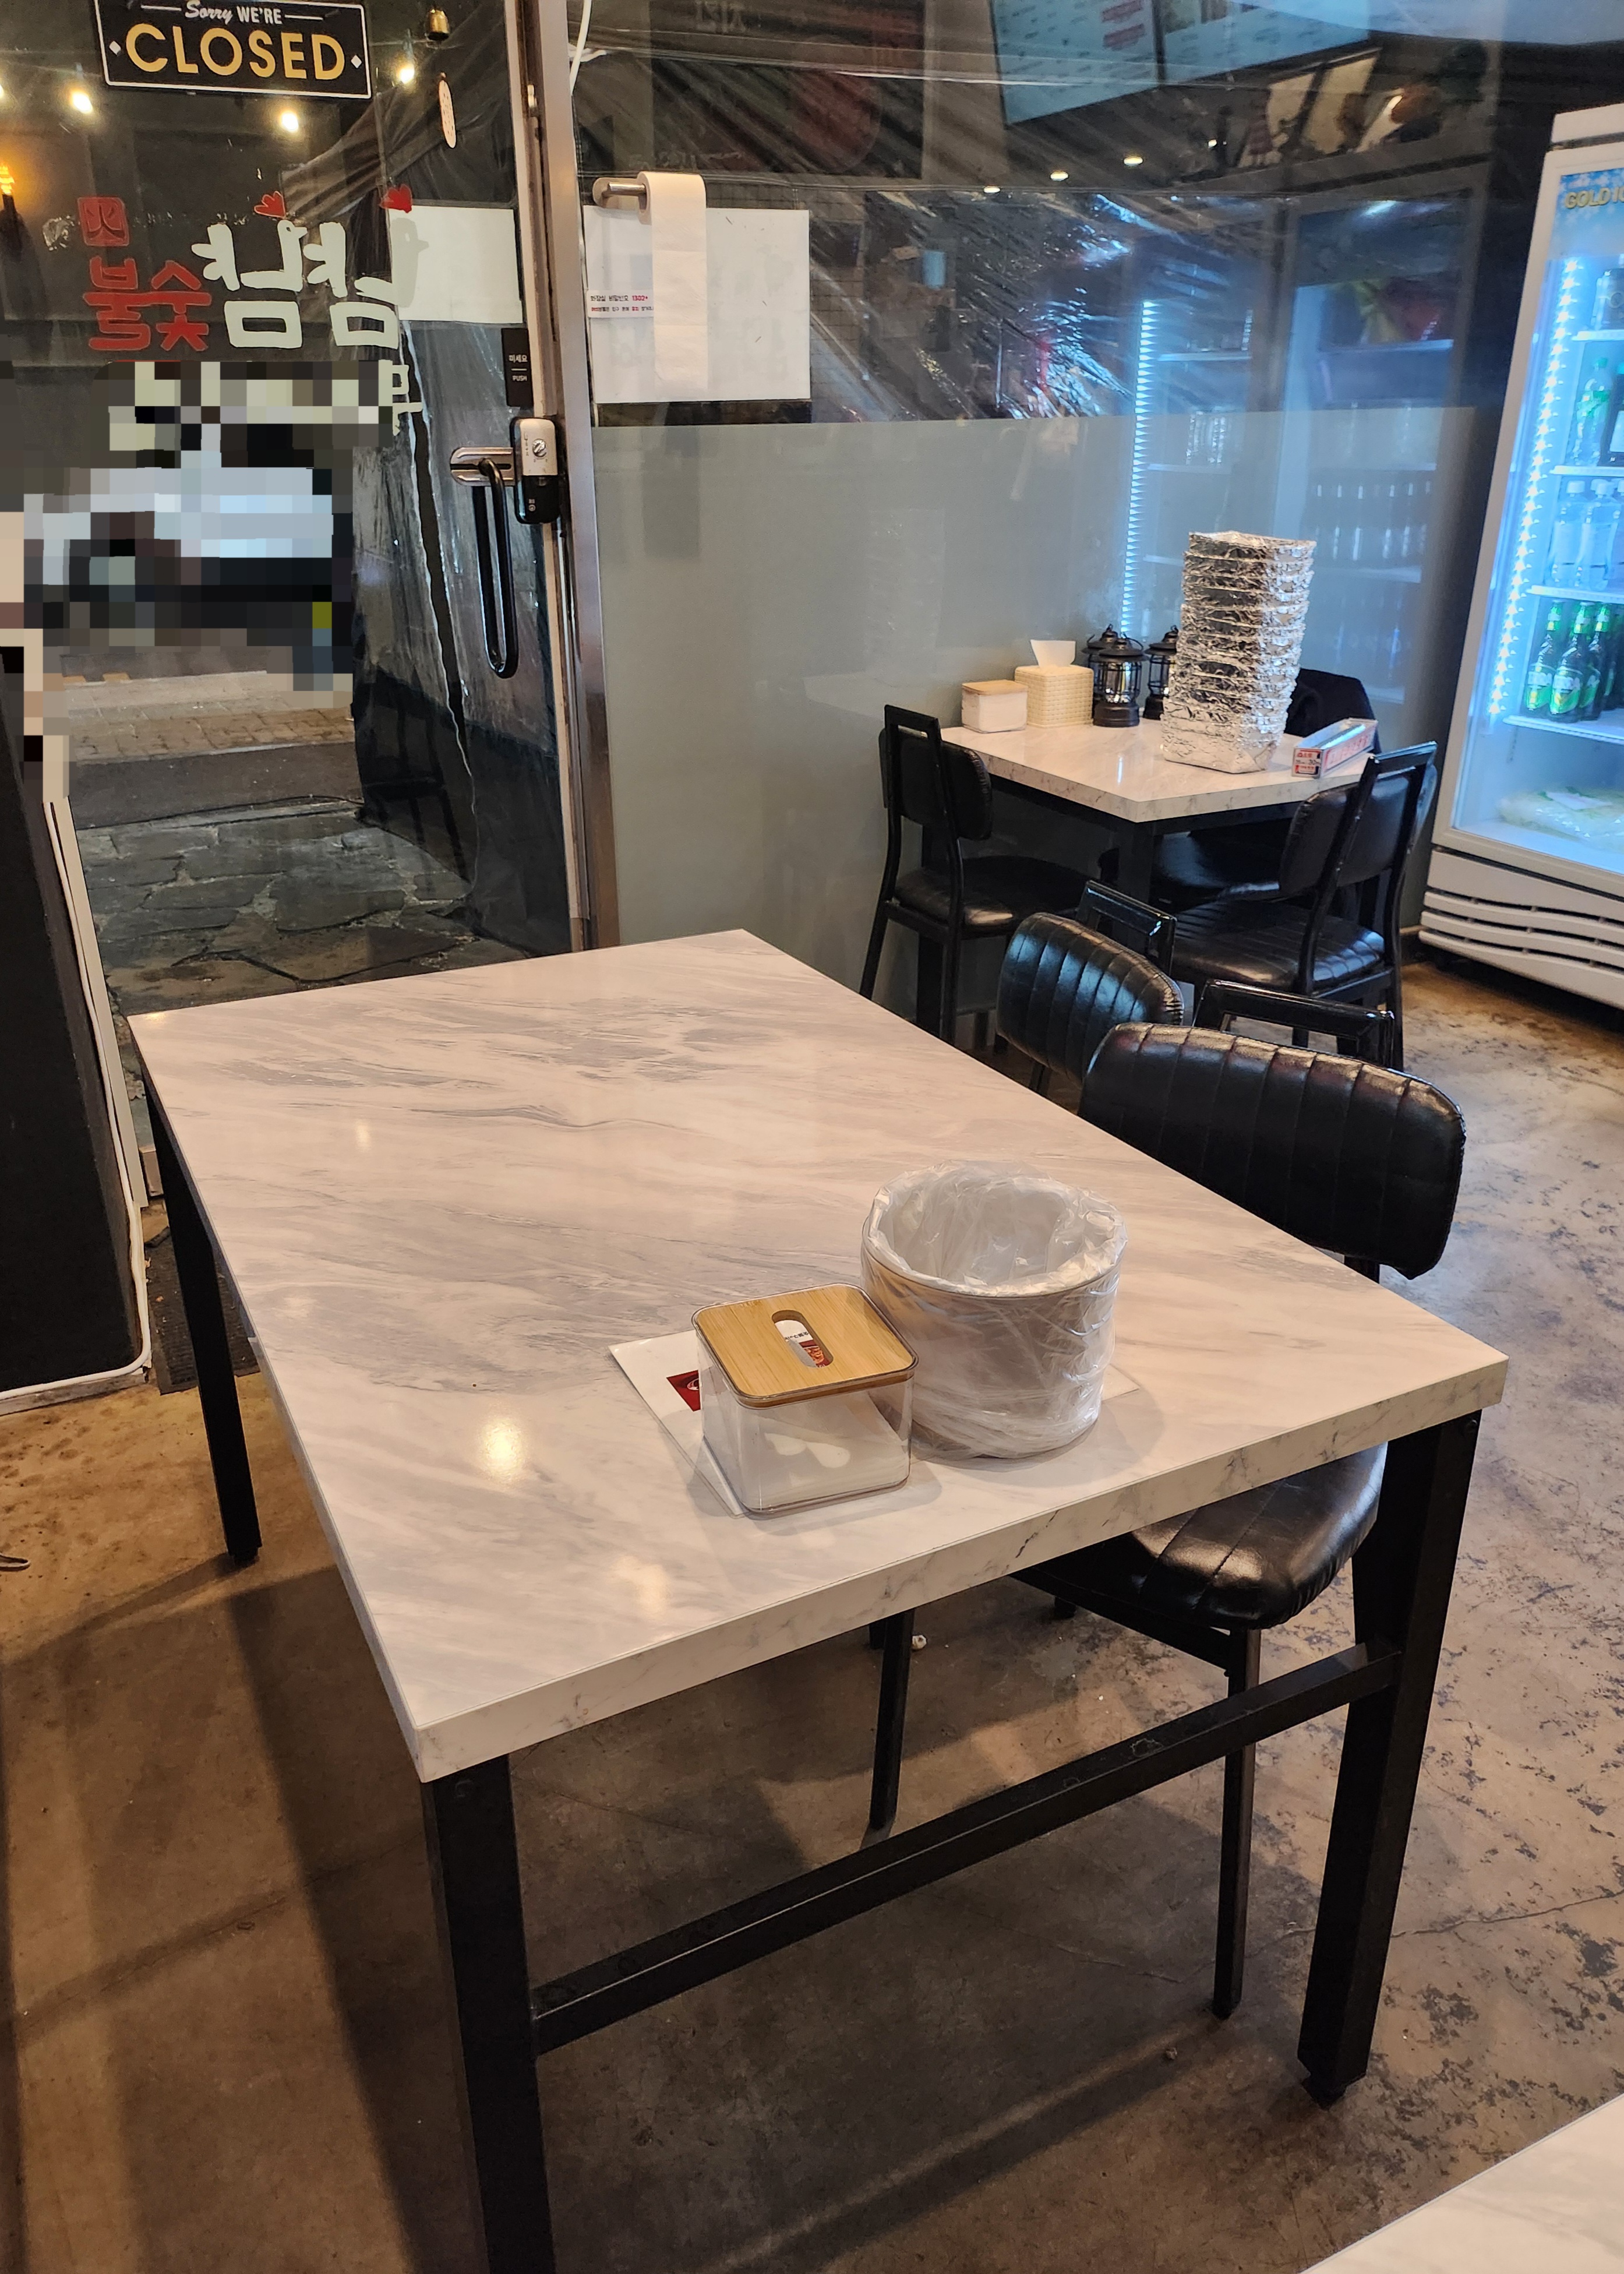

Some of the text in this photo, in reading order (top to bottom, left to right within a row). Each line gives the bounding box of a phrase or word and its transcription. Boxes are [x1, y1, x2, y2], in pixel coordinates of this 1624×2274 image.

[185, 0, 283, 25] Sorry WE'RE
[126, 23, 345, 80] CLOSED
[1565, 187, 1611, 209] GOLD
[509, 354, 528, 362] 미세요
